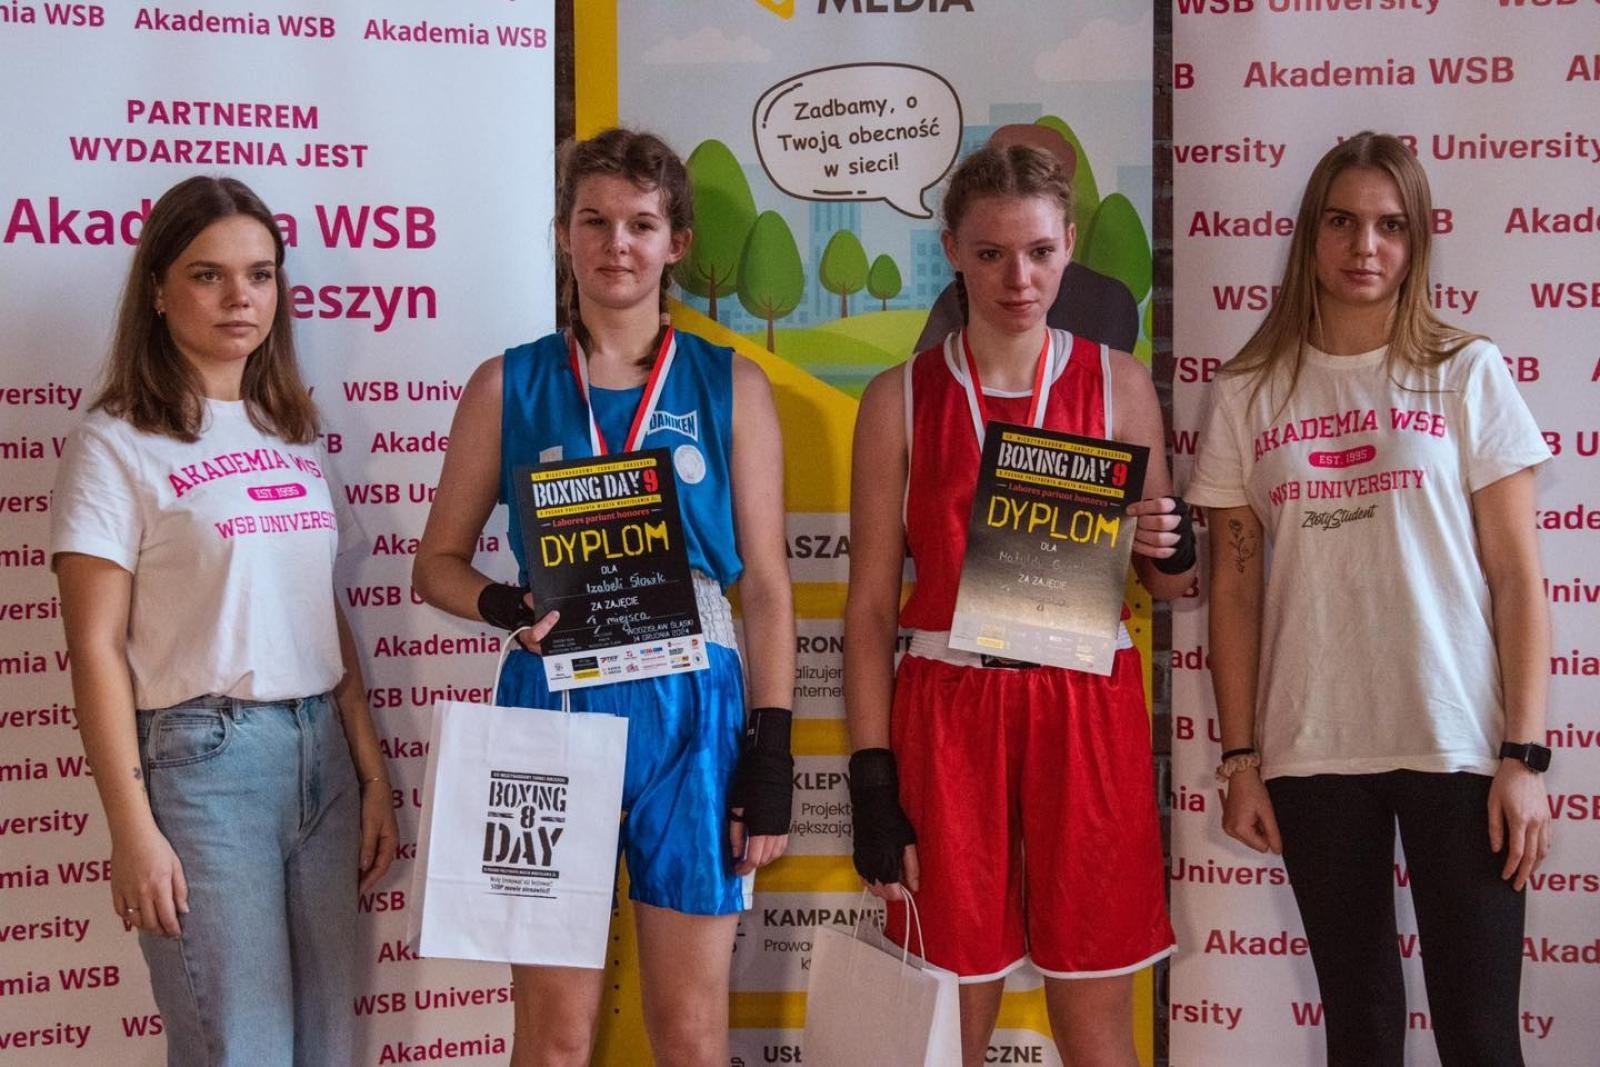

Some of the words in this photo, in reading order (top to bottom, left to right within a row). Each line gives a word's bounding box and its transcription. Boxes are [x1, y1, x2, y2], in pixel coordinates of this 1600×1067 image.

[44, 3, 105, 27] WSB
[134, 8, 270, 35] Akademia
[277, 15, 336, 38] WSB
[363, 19, 490, 45] Akademia
[496, 25, 548, 48] WSB
[1243, 58, 1415, 88] Akademia
[1428, 56, 1515, 84] WSB
[127, 99, 319, 130] PARTNEREM
[794, 98, 895, 121] Zadbamy,
[906, 96, 918, 108] o
[778, 131, 841, 154] Twoją
[849, 116, 941, 145] obecność
[69, 136, 287, 166] WYDARZENIA
[296, 143, 368, 168] JEST
[824, 164, 839, 177] w
[849, 152, 899, 175] sieci!
[1174, 137, 1286, 168] versity
[315, 204, 436, 249] WSB
[1504, 206, 1600, 234] Akad
[343, 381, 399, 402] WSB
[1254, 409, 1378, 462] AKADEMIA
[1390, 408, 1447, 438] WSB
[998, 442, 1069, 477] BOXING
[1112, 462, 1128, 487] 9
[1346, 449, 1368, 463] 1995
[168, 449, 290, 498] AKADEMIA
[344, 484, 400, 505] WSB
[532, 476, 601, 507] BOXING
[643, 469, 659, 493] 9
[1269, 481, 1300, 506] WSB
[1307, 470, 1424, 499] UNIVERSITY
[214, 516, 257, 540] WSB
[552, 515, 585, 528] Labores
[987, 495, 1120, 548] DYPLOM
[540, 520, 670, 567] DYPLOM
[1040, 542, 1057, 552] DLA
[601, 565, 618, 575] DLA
[1018, 574, 1030, 584] ZA
[346, 586, 401, 607] WSB
[590, 601, 602, 611] ZA
[604, 596, 640, 610] ZAJĘCIE
[374, 633, 501, 657] Akademia
[489, 781, 567, 813] BOXING
[802, 802, 851, 820] Projekt
[520, 805, 536, 829] 8
[483, 822, 564, 867] DAY
[59, 966, 120, 990] WSB
[353, 992, 406, 1016] WSB
[379, 1034, 506, 1065] Akademia
